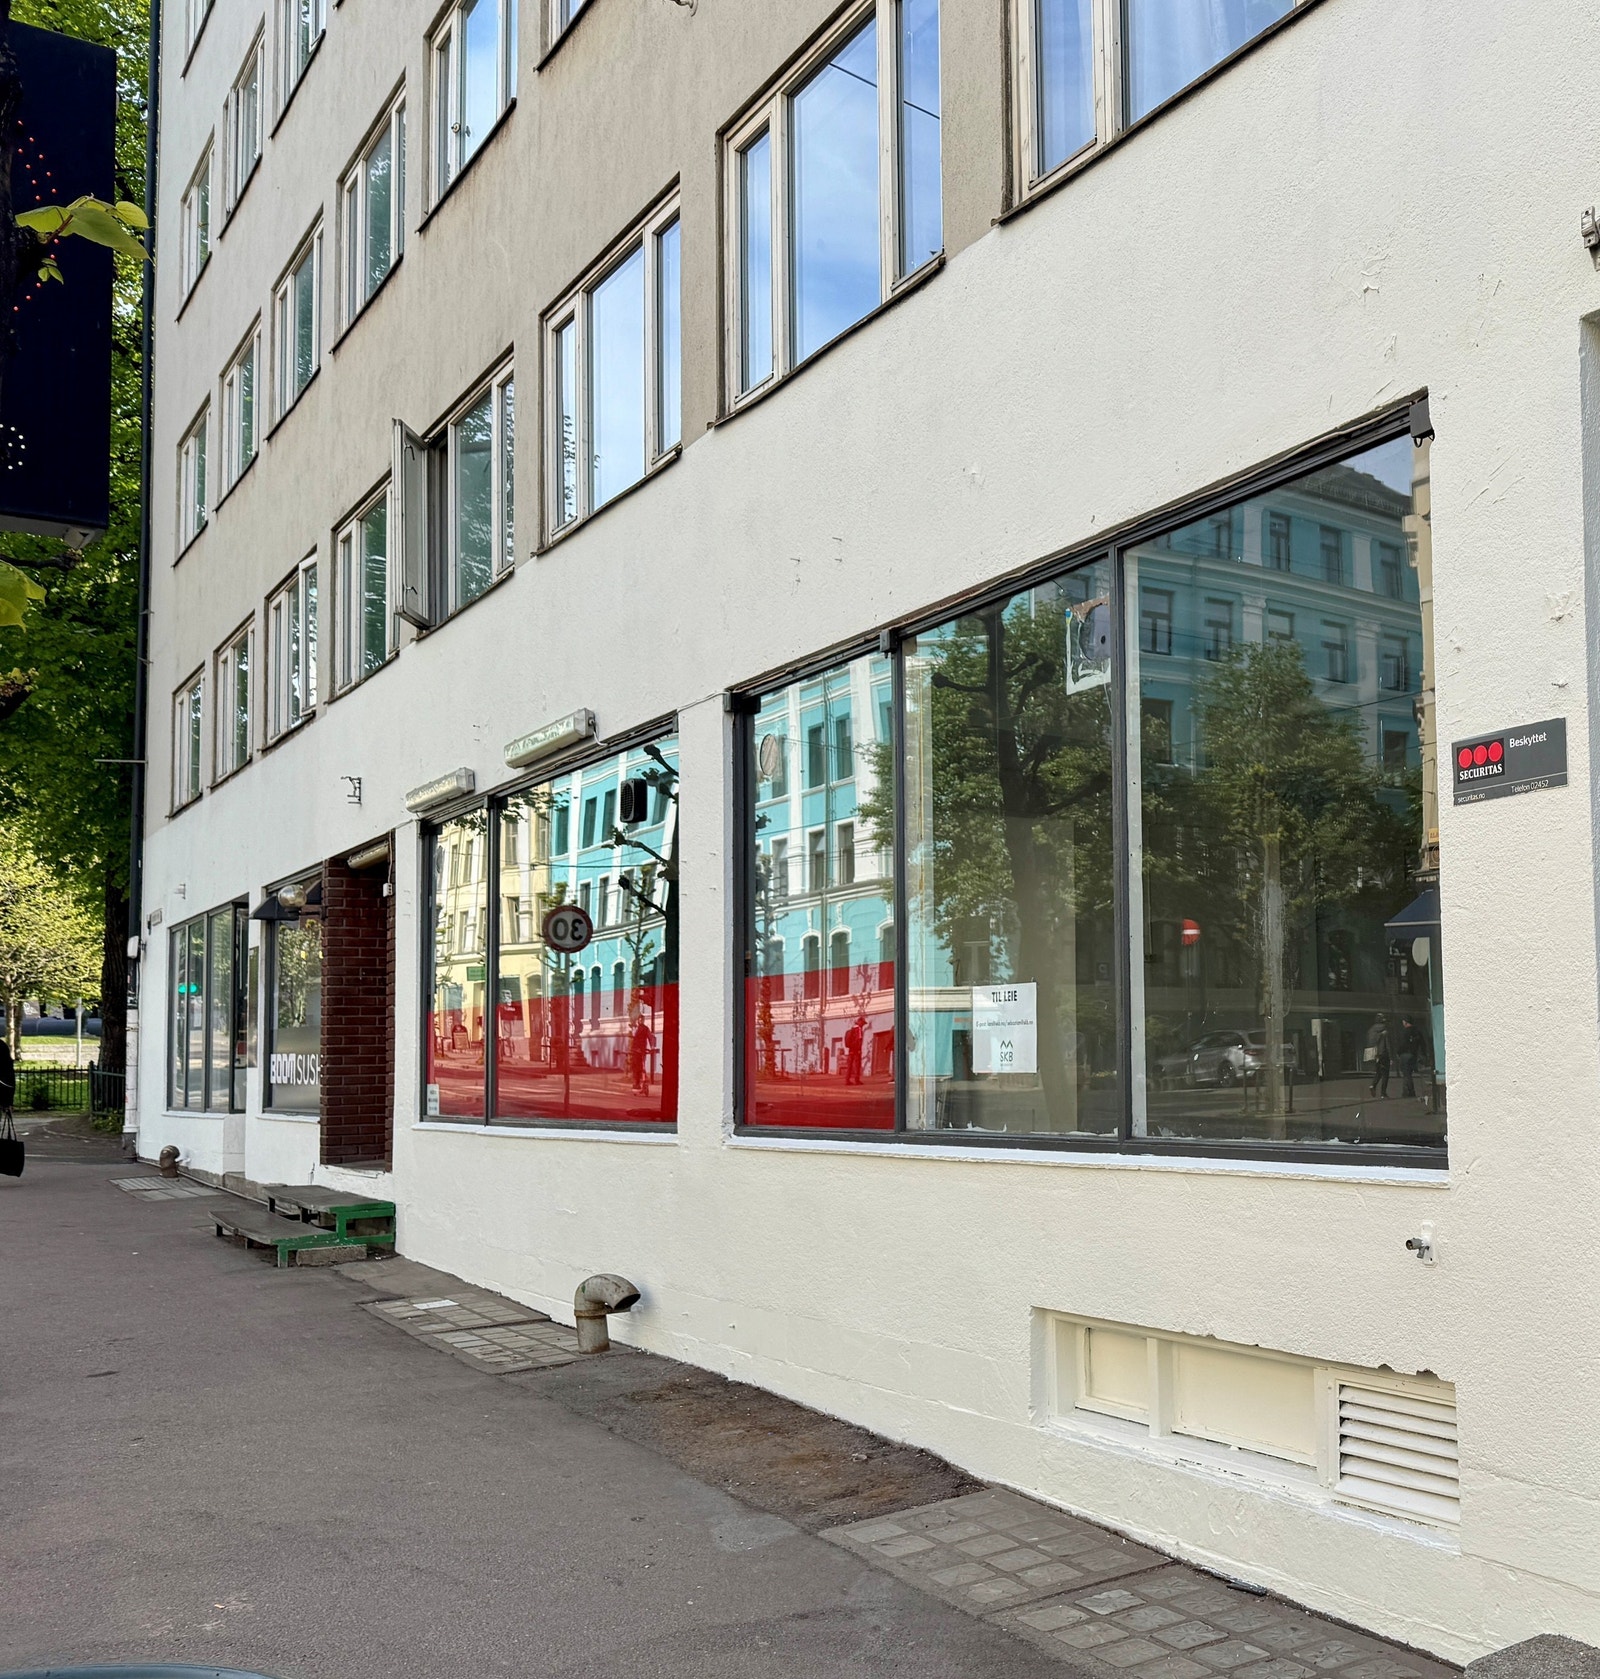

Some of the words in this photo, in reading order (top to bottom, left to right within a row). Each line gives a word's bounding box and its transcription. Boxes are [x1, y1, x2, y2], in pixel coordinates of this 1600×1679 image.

[1509, 731, 1547, 748] Beskyttet
[1459, 763, 1503, 781] SECURITAS
[1511, 784, 1530, 795] Telefon
[1457, 792, 1486, 803] securitas.no
[991, 991, 1002, 1002] TIL
[1003, 990, 1018, 1002] LEIE
[1000, 1051, 1014, 1062] SKB
